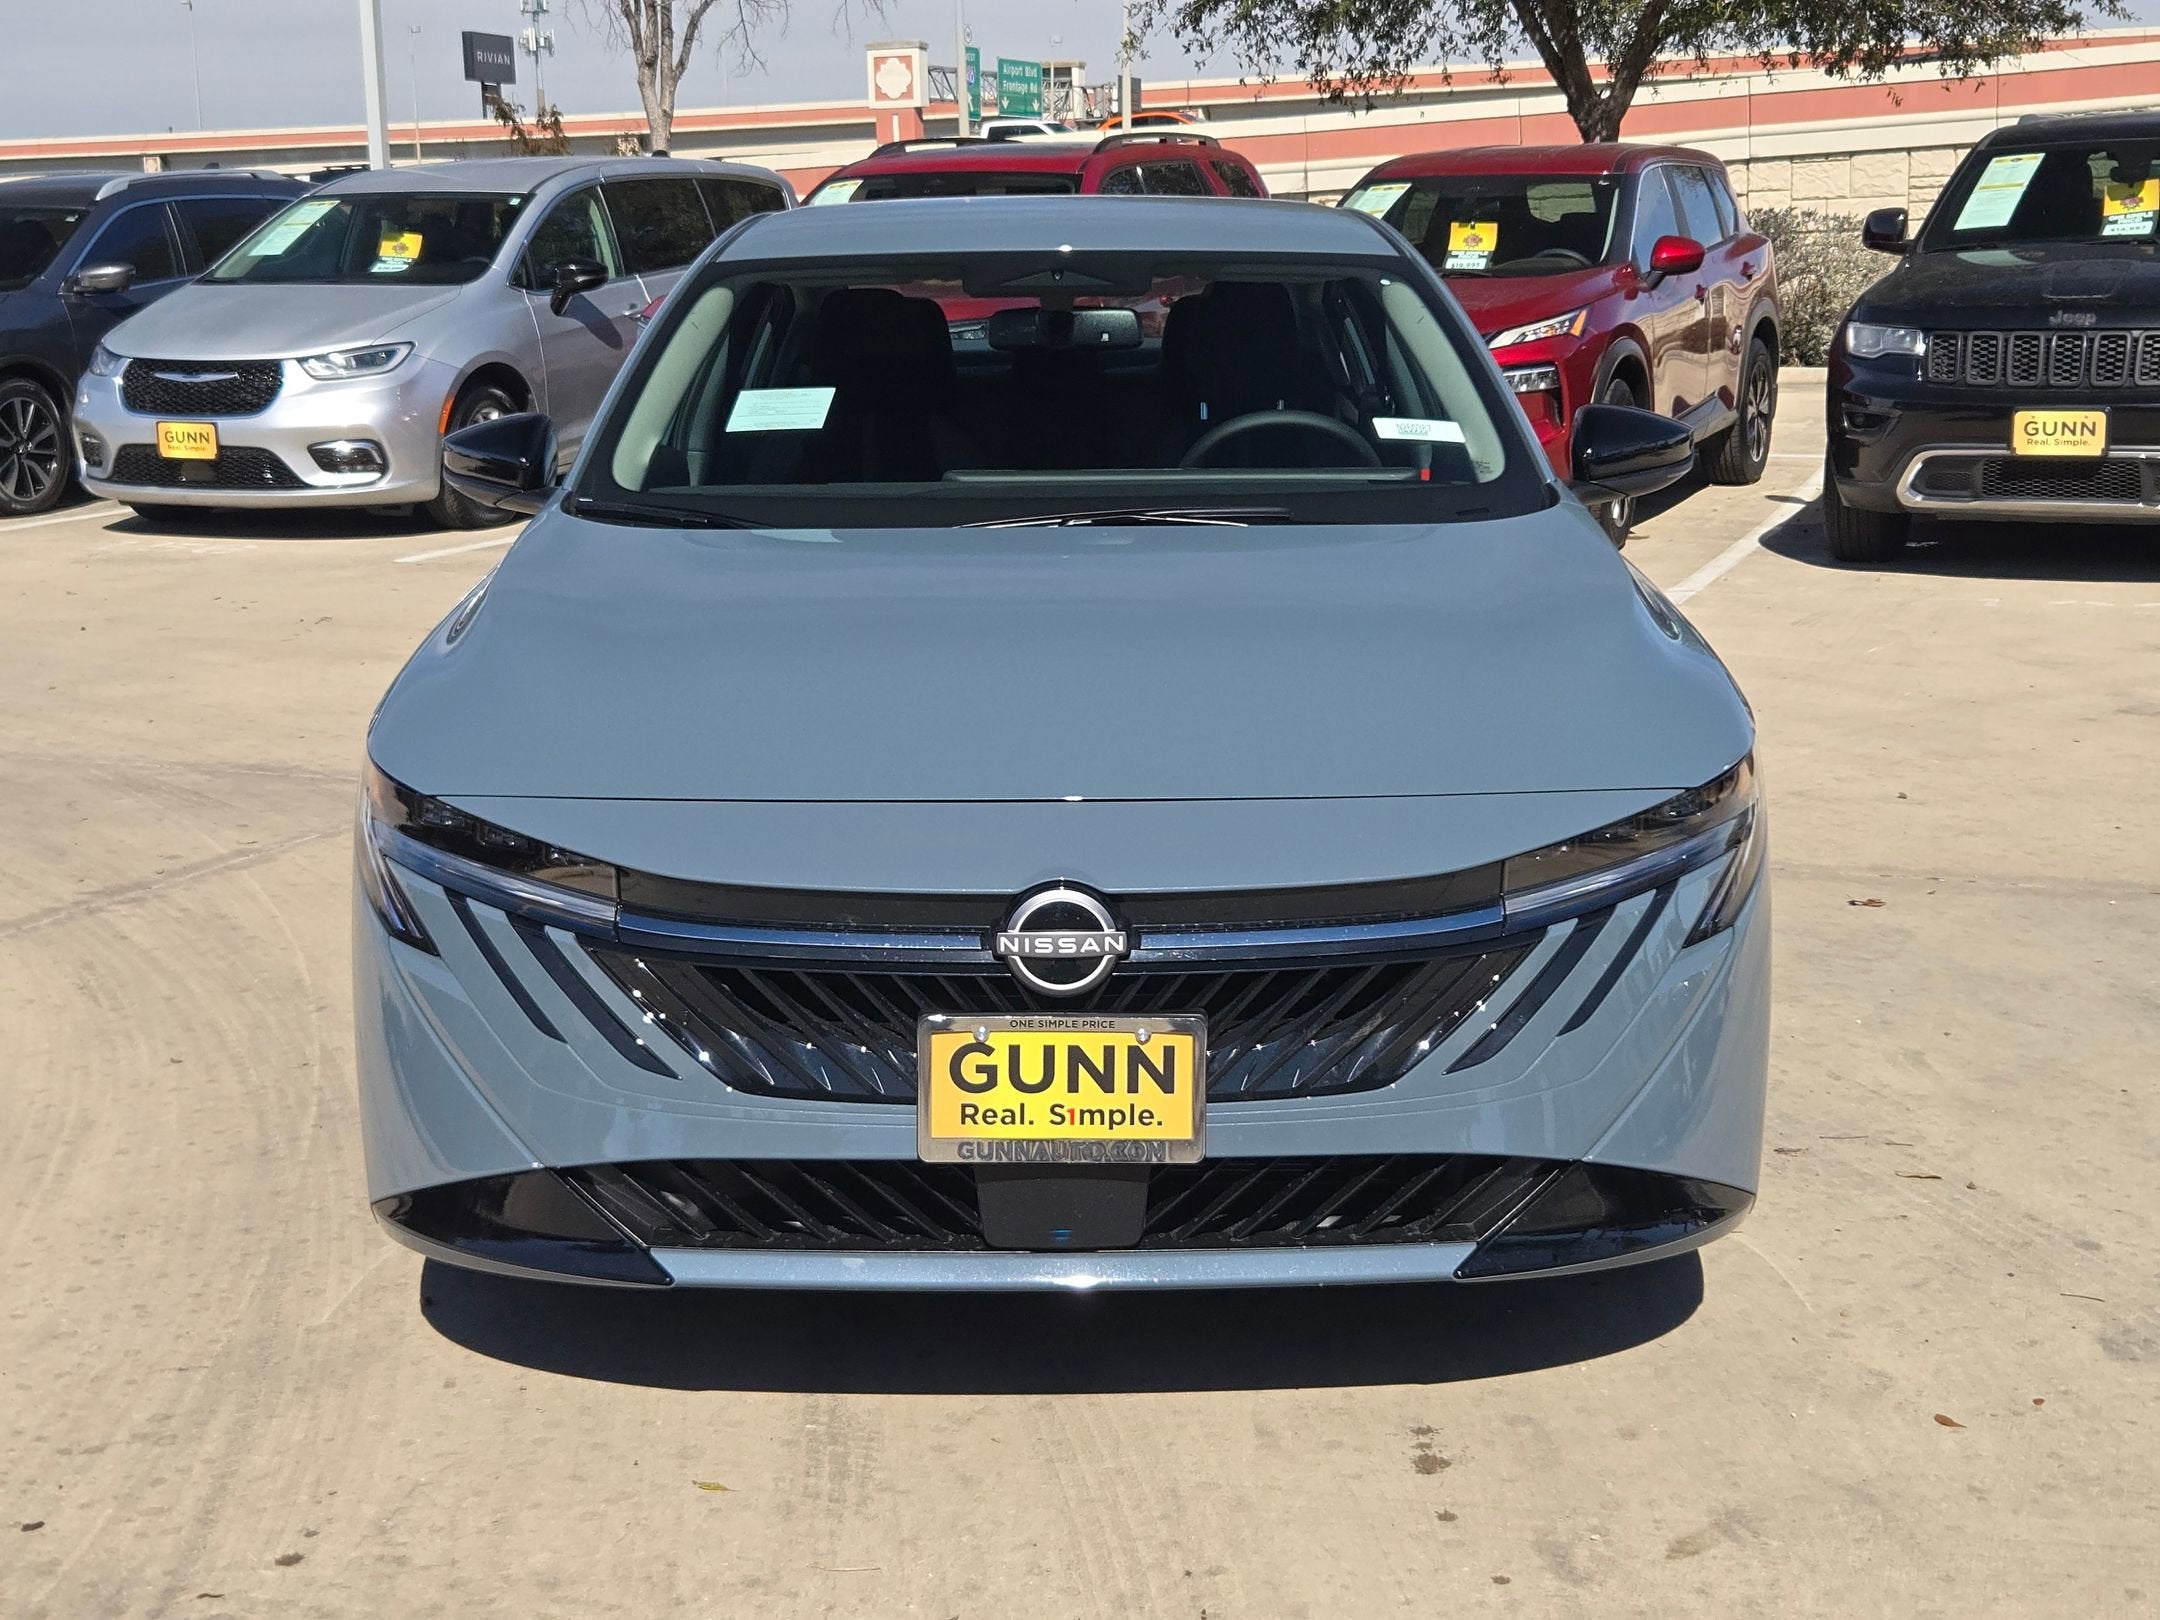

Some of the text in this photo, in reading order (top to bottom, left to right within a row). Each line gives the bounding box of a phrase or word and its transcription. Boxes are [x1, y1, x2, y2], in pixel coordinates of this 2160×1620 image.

[477, 51, 510, 65] RIVIAN
[1003, 64, 1038, 78] Airport Blvd
[1003, 81, 1038, 95] Frontage Rd
[2049, 310, 2097, 326] Jeep
[2024, 421, 2096, 436] GUNN
[165, 431, 210, 444] GUNN
[999, 936, 1124, 953] NISSAN
[1010, 1020, 1115, 1029] ONE SIMPLE PRICE
[949, 1042, 1175, 1094] GUNN
[960, 1103, 1034, 1126] Real.
